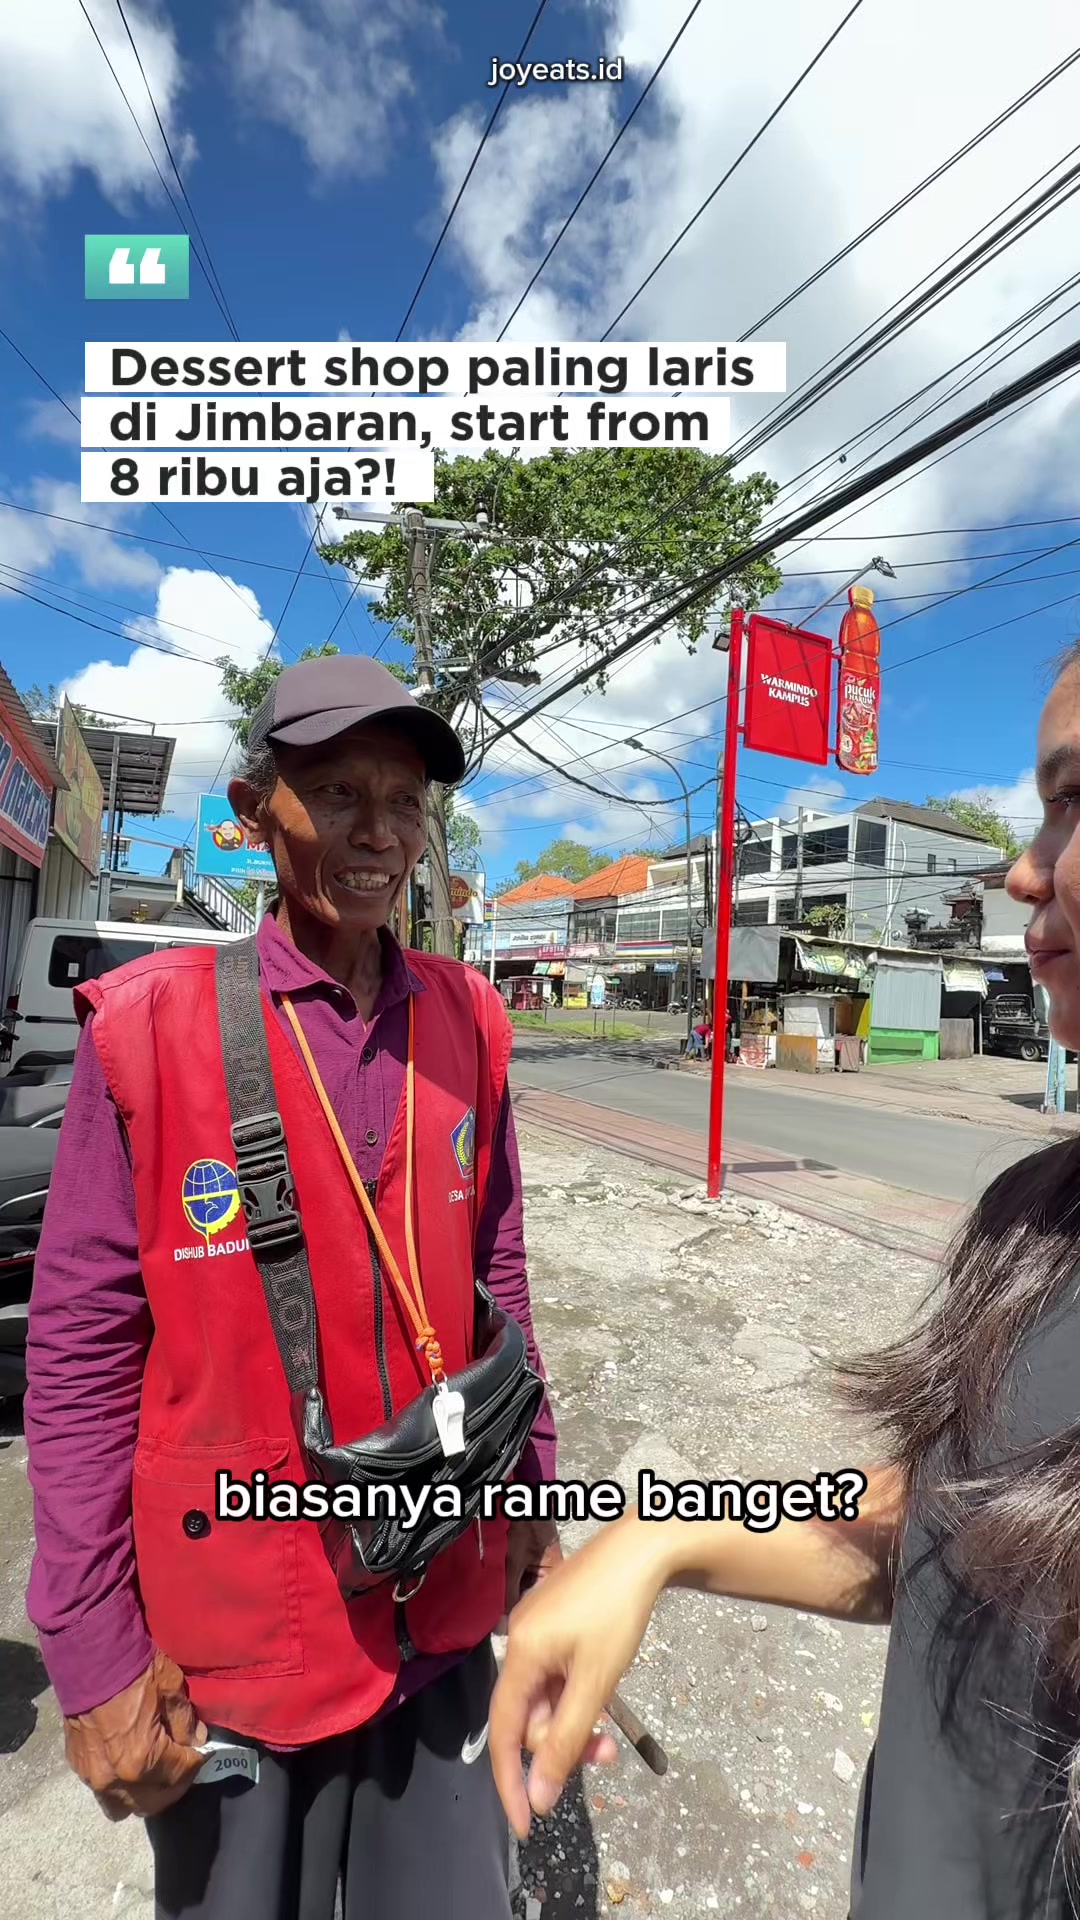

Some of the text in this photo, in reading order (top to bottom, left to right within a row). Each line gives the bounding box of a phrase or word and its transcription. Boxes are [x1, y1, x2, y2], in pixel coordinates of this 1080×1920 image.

[760, 673, 818, 698] WARMINDO
[768, 687, 810, 708] KAMPUS
[173, 1246, 206, 1262] DISHUB
[214, 1757, 249, 1773] 2000
